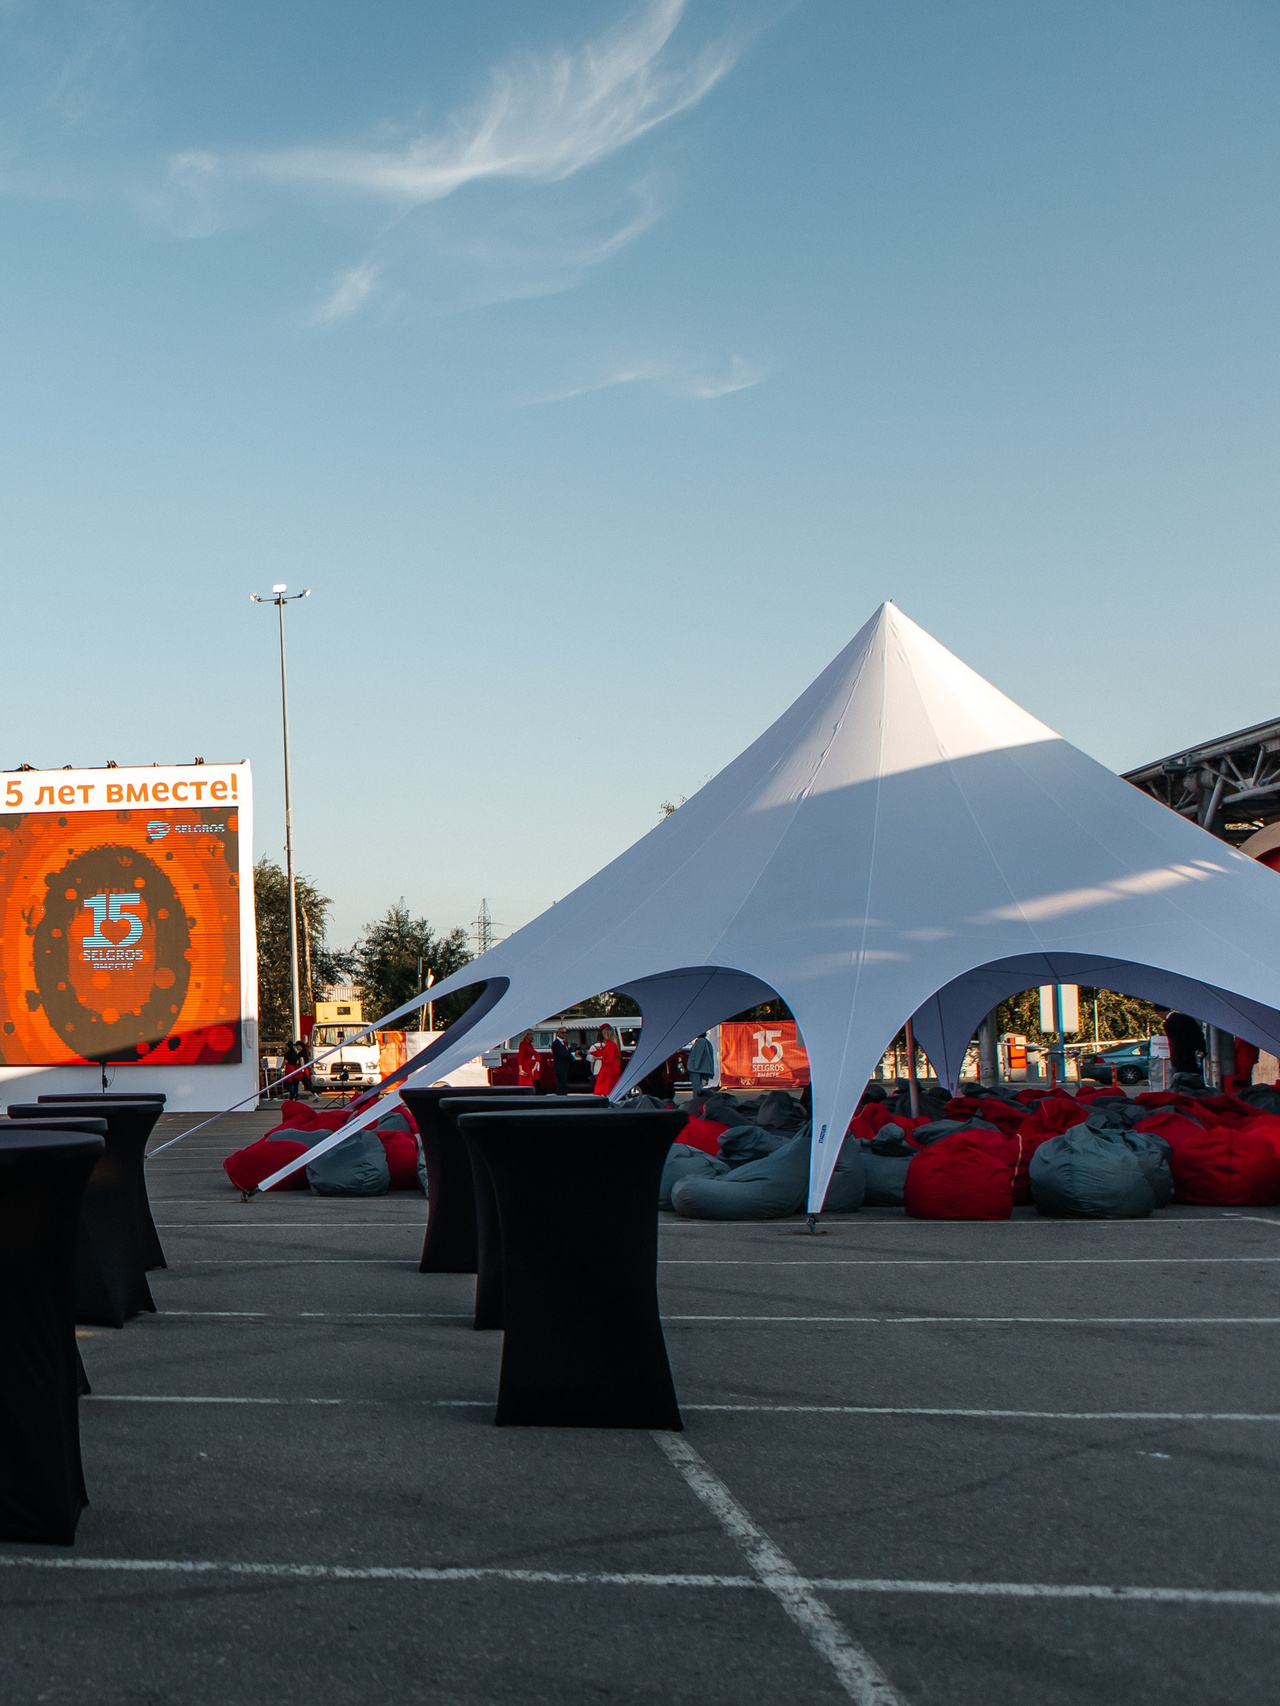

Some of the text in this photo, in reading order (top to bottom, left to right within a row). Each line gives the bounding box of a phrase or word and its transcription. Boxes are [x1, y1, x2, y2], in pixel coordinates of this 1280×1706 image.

[35, 784, 95, 805] лет
[106, 773, 239, 803] вместе!
[174, 823, 226, 834] SELGROS
[82, 893, 144, 948] 15
[82, 949, 144, 961] SELGROS
[752, 1030, 784, 1064] 15
[752, 1064, 785, 1072] SELGROS
